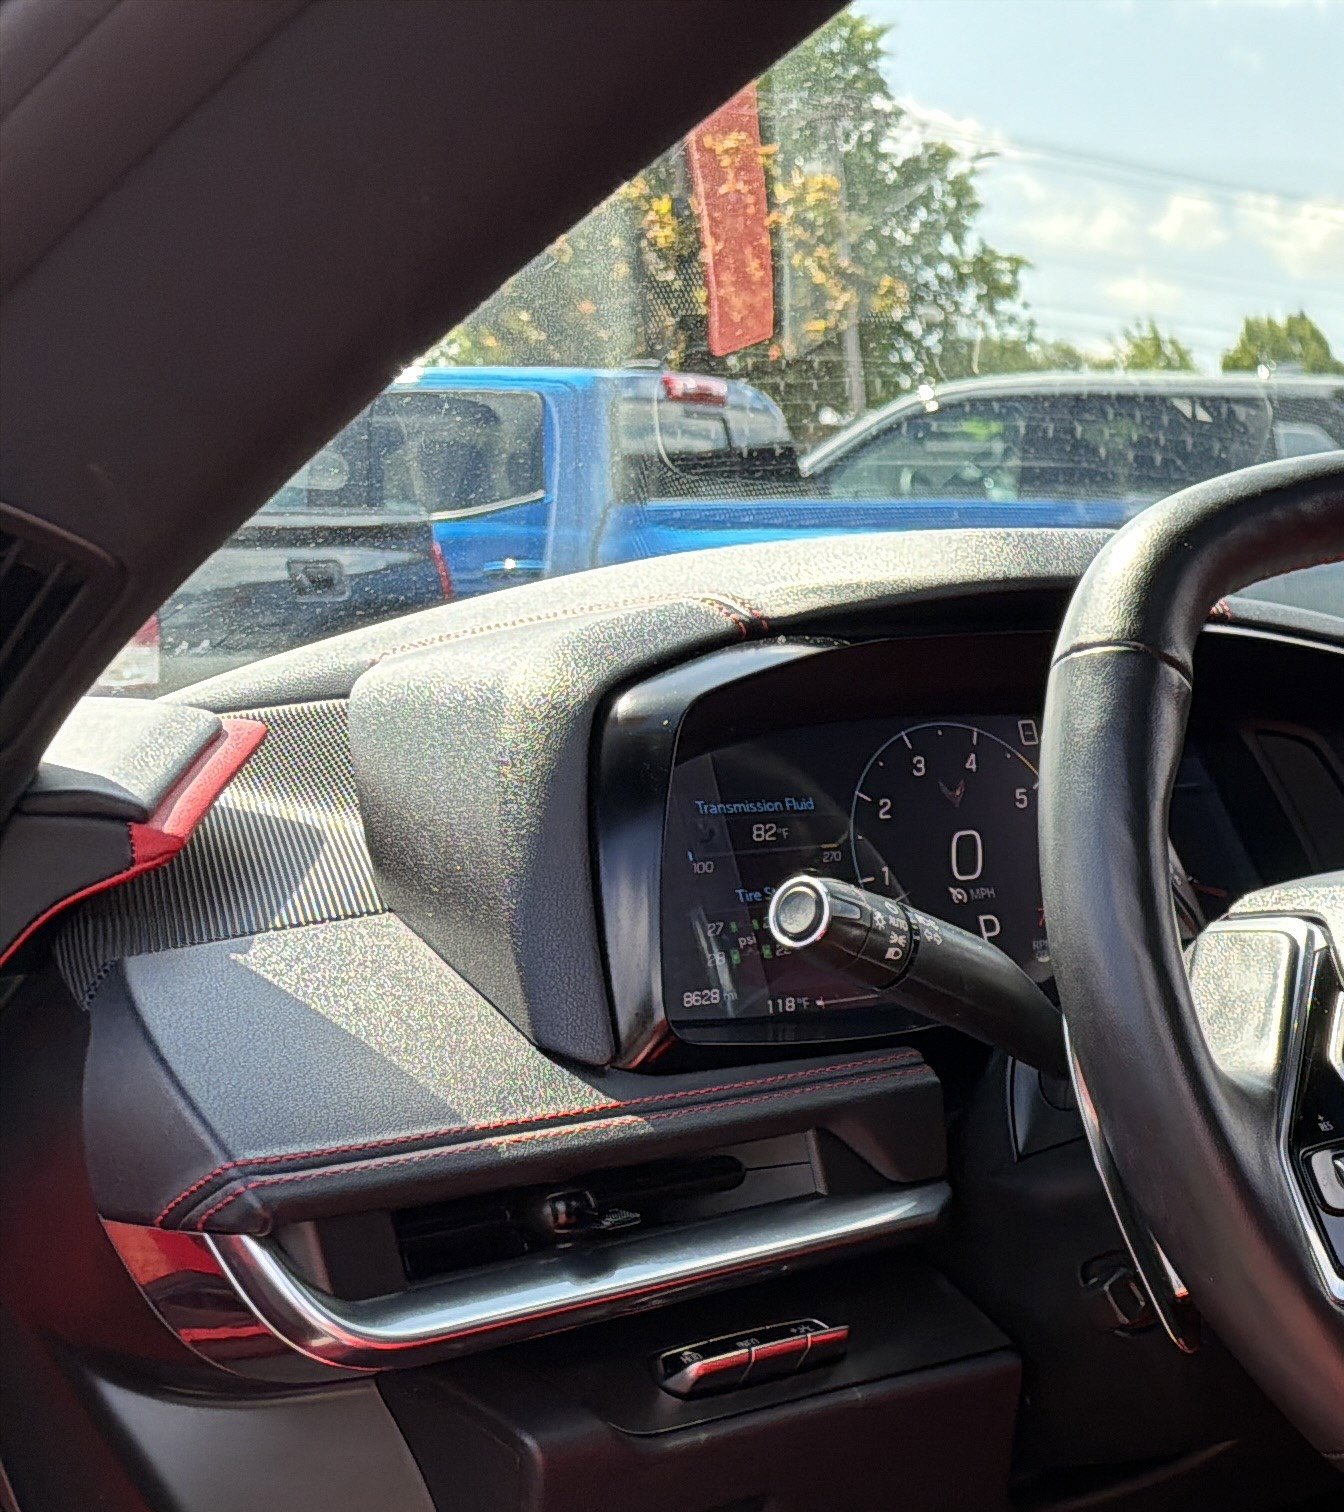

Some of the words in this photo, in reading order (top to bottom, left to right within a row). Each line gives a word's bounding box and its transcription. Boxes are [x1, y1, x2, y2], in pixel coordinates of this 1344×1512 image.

[913, 755, 926, 777] 3
[965, 753, 977, 773] 4
[695, 799, 784, 816] Transmission
[786, 797, 816, 812] Fluid
[1015, 788, 1028, 809] 5
[878, 799, 892, 820] 2
[822, 850, 842, 864] 270
[950, 829, 983, 881] 0
[692, 860, 715, 875] 100
[881, 866, 890, 886] 1
[735, 888, 763, 903] Tire
[971, 887, 996, 900] MPH
[707, 921, 725, 937] 27
[977, 914, 1001, 942] P
[738, 932, 757, 950] psi
[682, 990, 720, 1008] 8628
